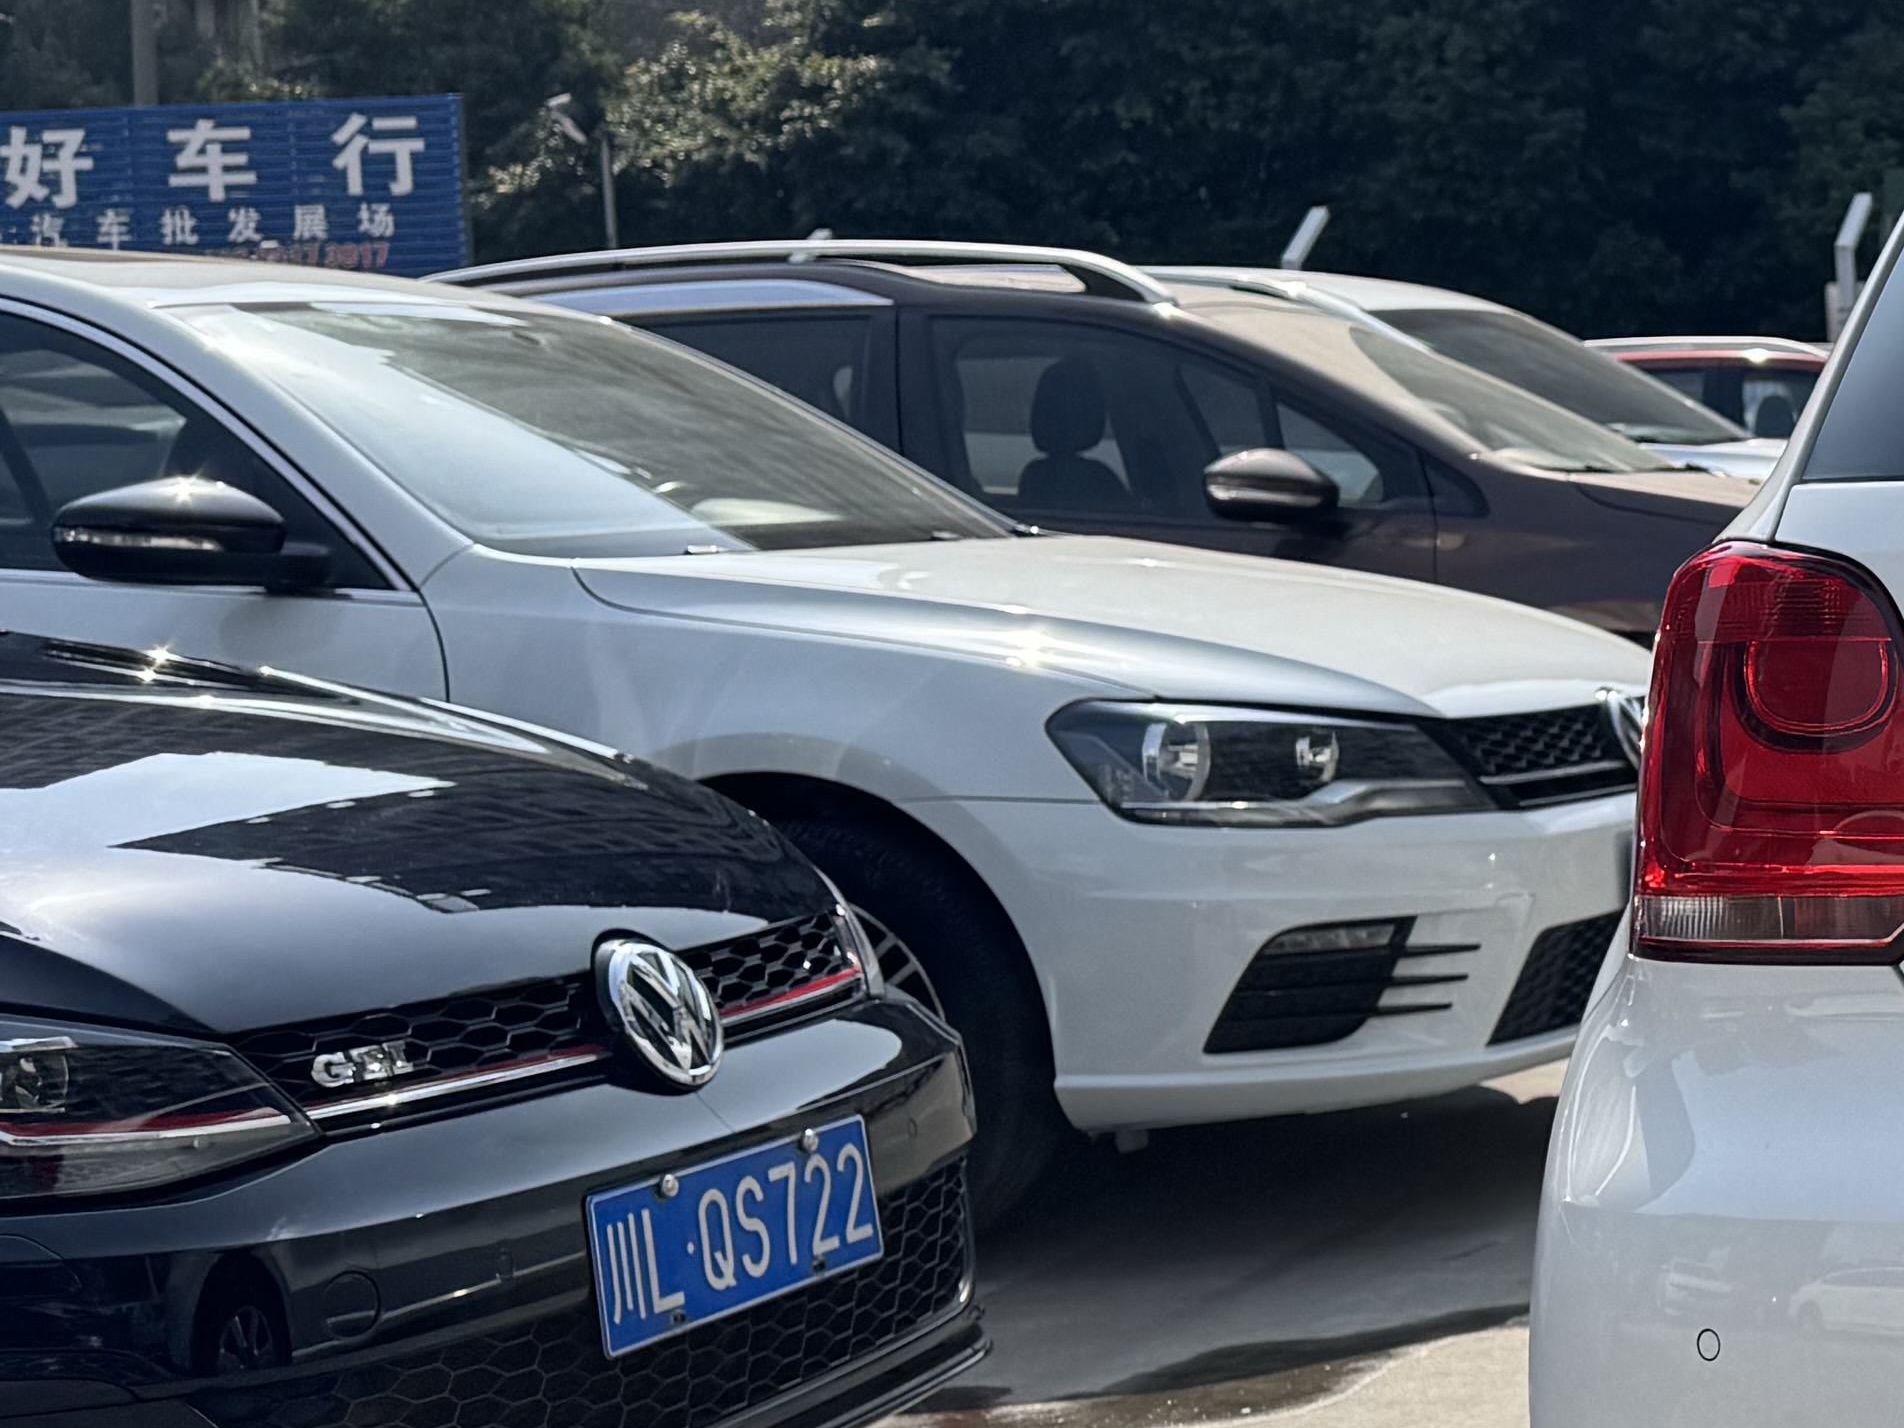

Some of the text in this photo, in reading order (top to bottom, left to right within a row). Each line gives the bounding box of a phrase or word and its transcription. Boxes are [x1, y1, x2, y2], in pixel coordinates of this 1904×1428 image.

[0, 113, 426, 209] 好车行
[606, 1142, 874, 1325] 川L·QS722
